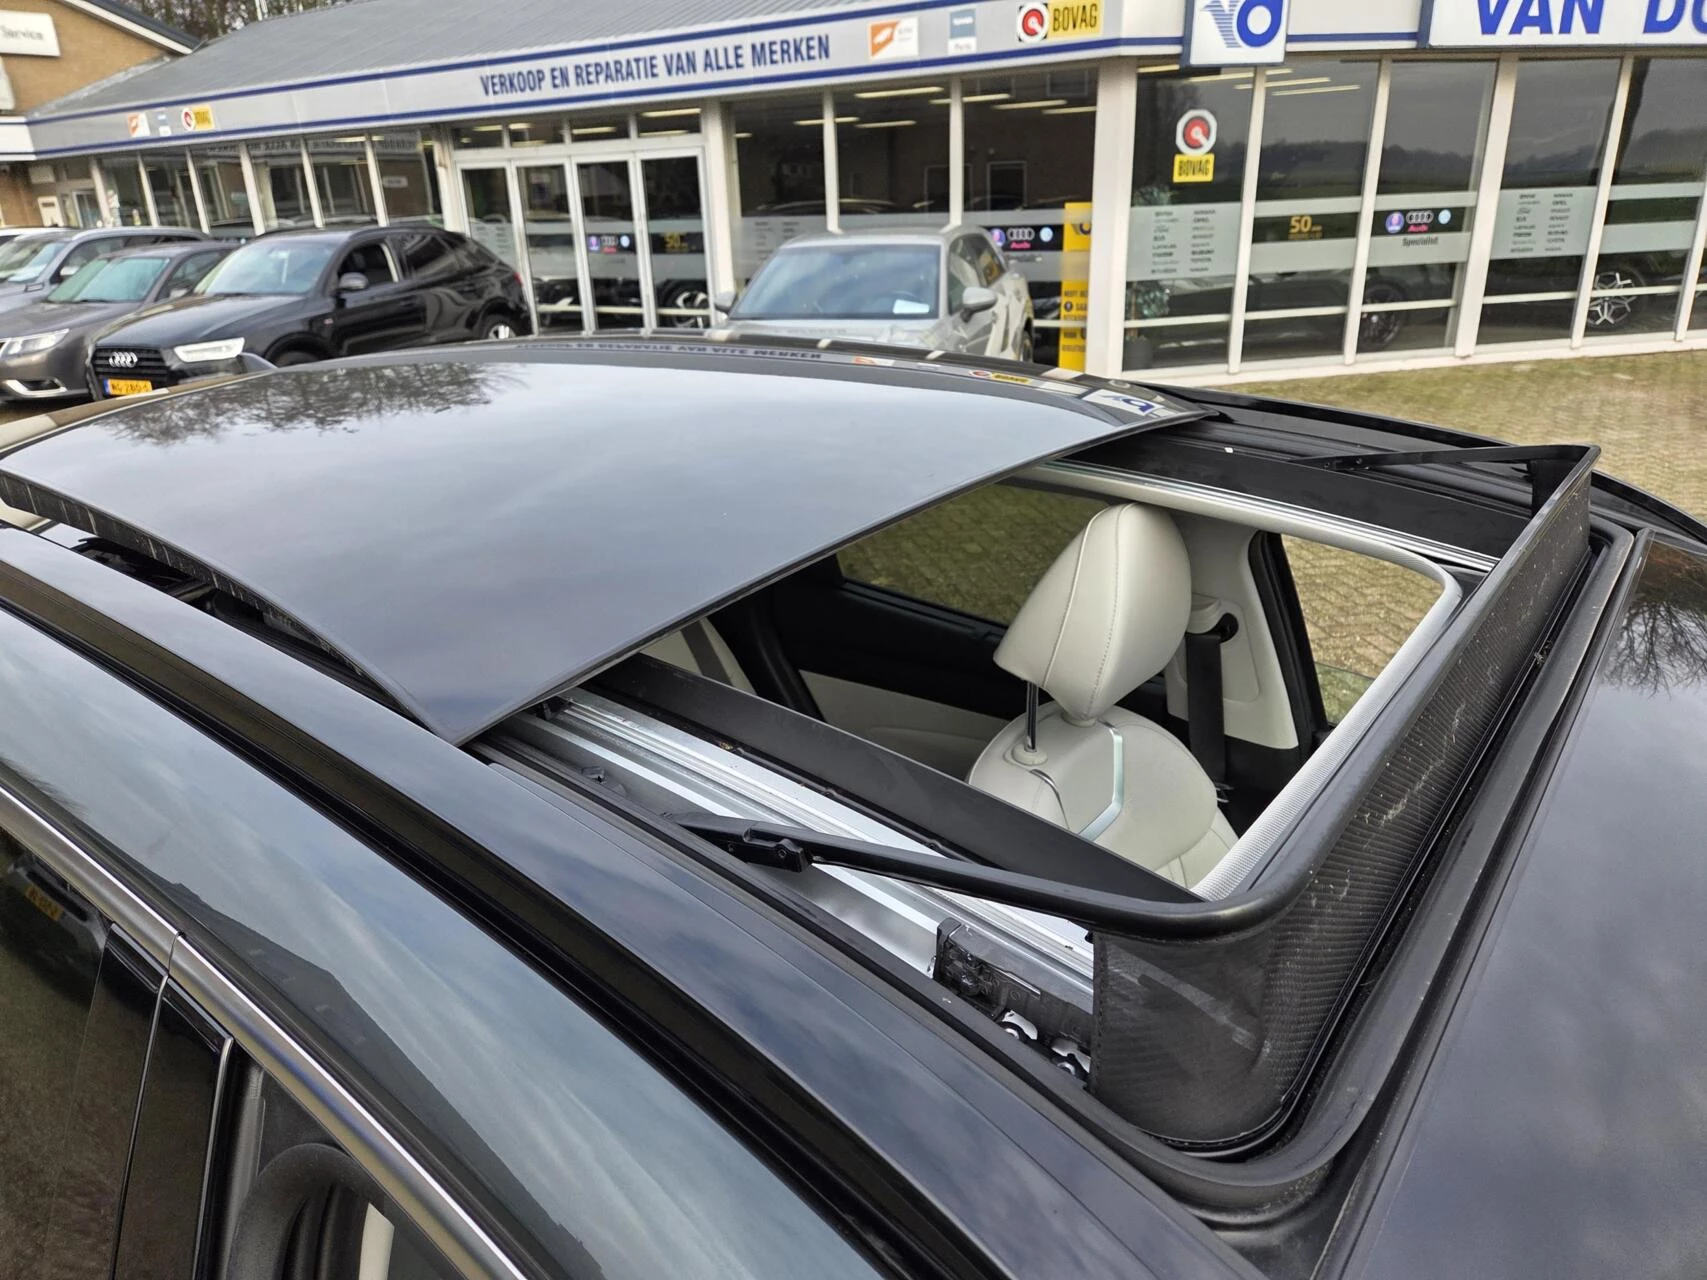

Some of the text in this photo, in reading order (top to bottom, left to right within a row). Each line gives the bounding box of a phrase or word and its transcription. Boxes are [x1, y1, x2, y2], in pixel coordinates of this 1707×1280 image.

[1052, 2, 1098, 32] BOVAG
[1477, 0, 1605, 35] VAN
[480, 33, 831, 97] VERKOOP EN REPARATIE VAN ALLE MERKEN
[1178, 158, 1211, 178] BOVAG
[1290, 214, 1313, 234] 50
